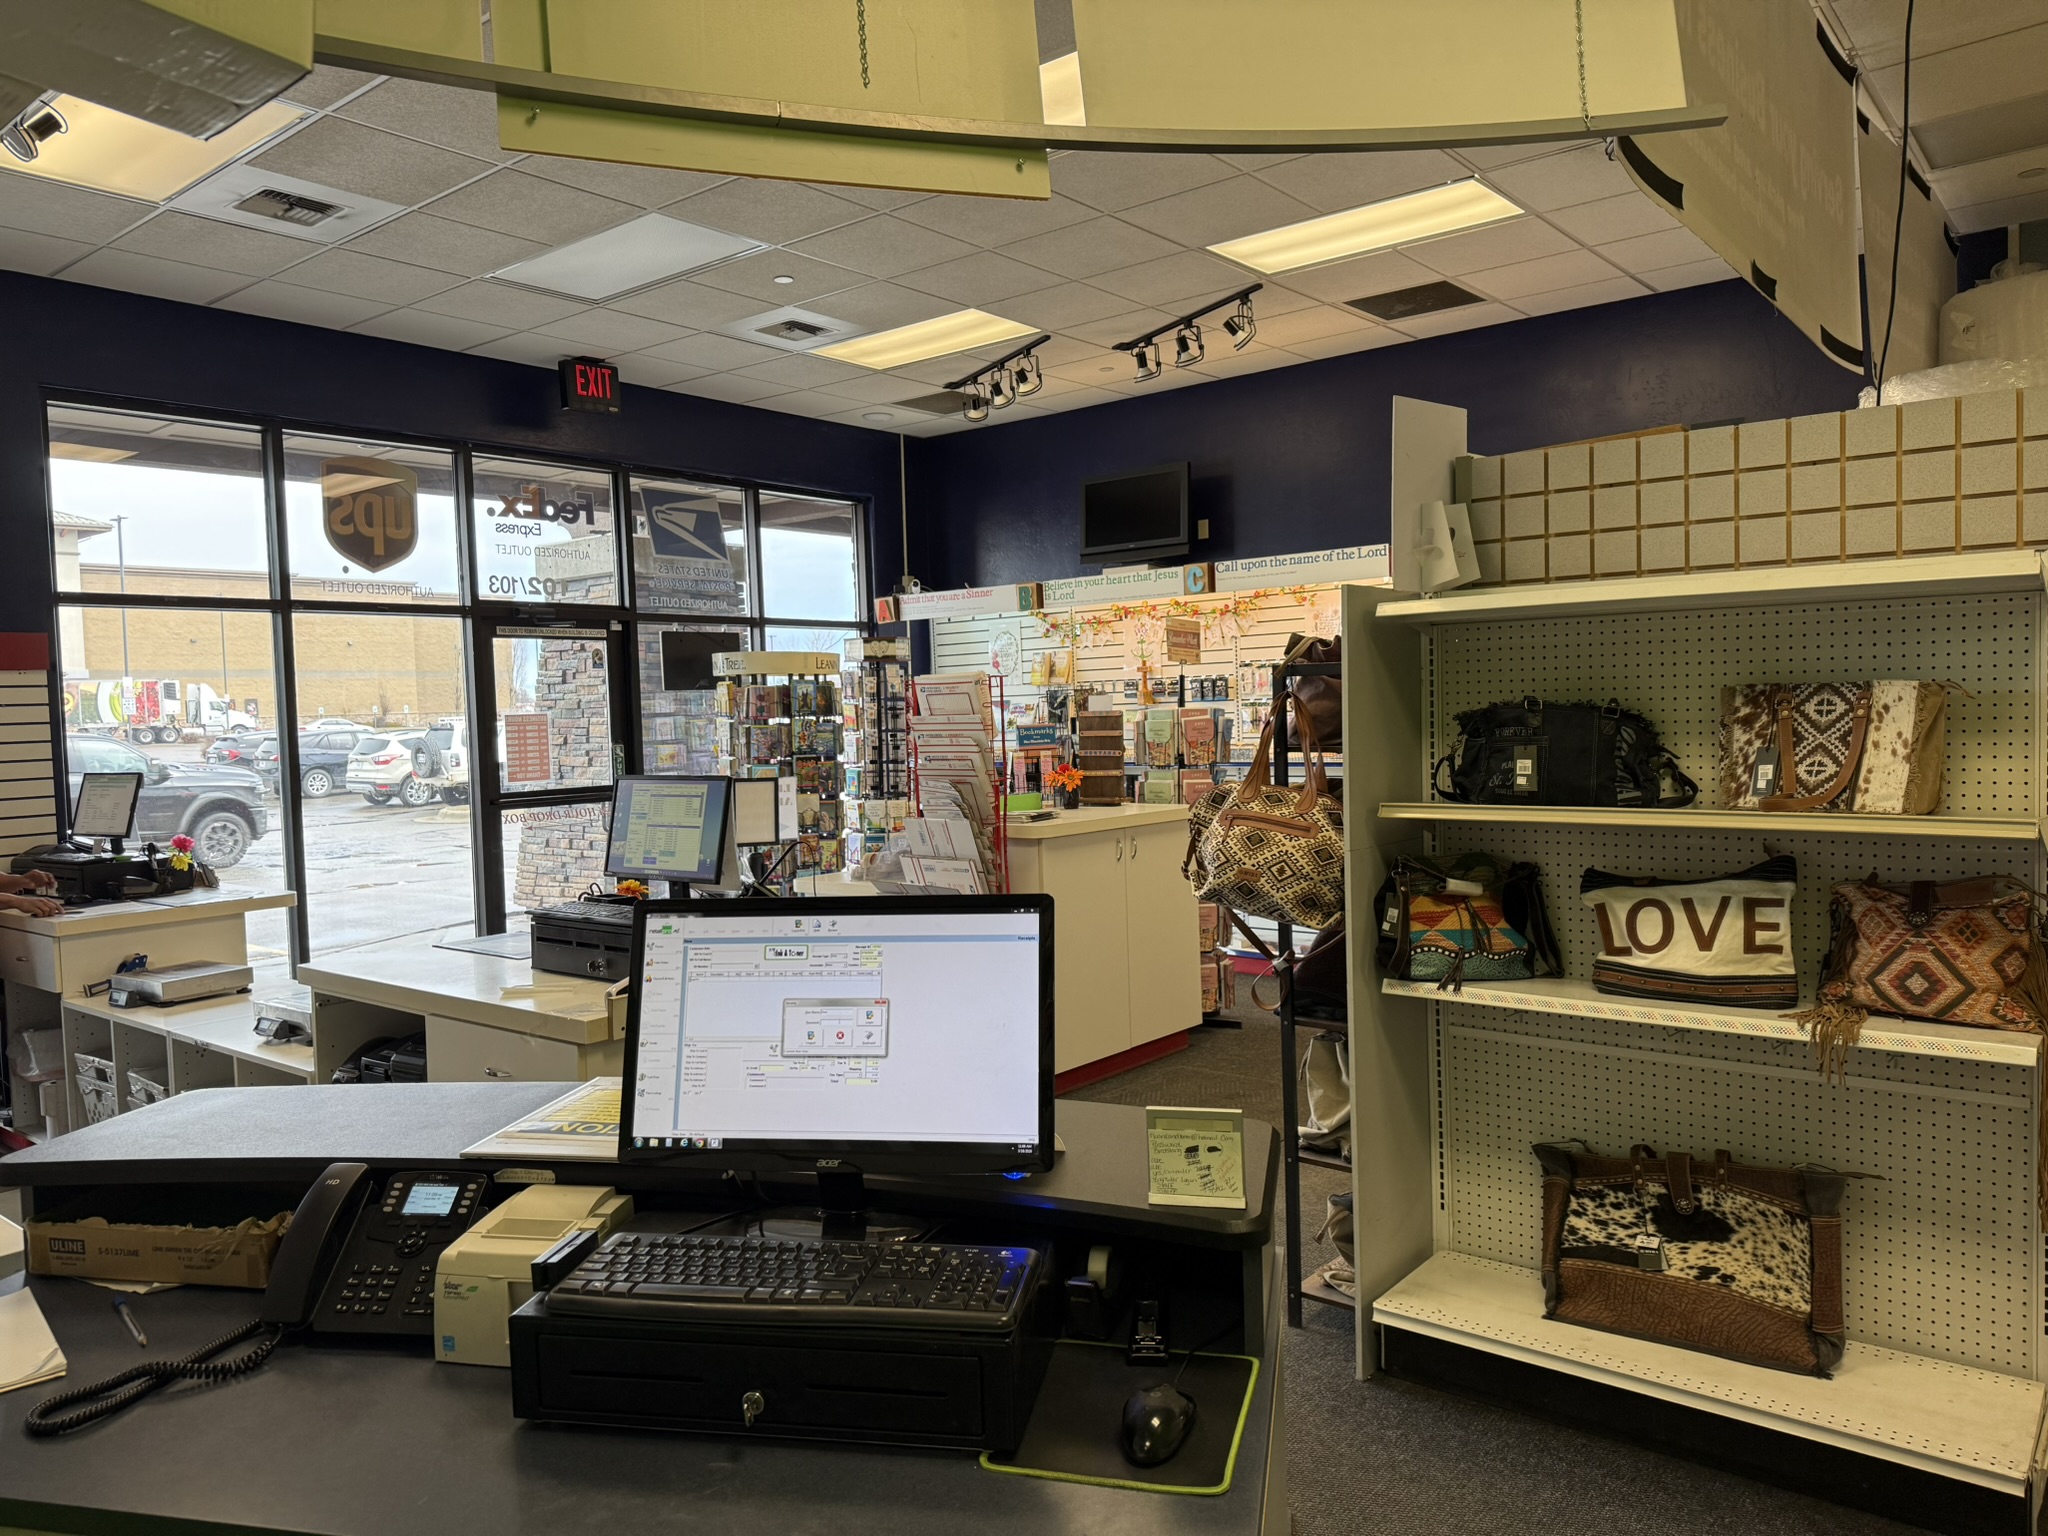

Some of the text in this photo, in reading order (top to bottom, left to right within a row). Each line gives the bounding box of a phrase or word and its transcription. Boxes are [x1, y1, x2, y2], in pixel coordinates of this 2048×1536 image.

[576, 364, 612, 399] EXIT
[1215, 545, 1387, 574] Call upon the name of the Lord
[1044, 569, 1179, 592] Believe in your heart that Jesus
[1187, 565, 1204, 593] C
[900, 595, 921, 606] Admit
[921, 594, 934, 603] that
[936, 594, 949, 604] you
[949, 593, 961, 601] are
[966, 589, 994, 599] Sinner
[1018, 586, 1033, 611] B
[1045, 591, 1052, 600] is
[1053, 589, 1075, 600] Lord
[878, 600, 892, 622] A
[1020, 728, 1053, 736] Bookmarks
[1494, 726, 1533, 737] FOREVER
[1594, 896, 1785, 957] LOVE
[816, 1158, 842, 1167] acer
[51, 1240, 84, 1253] ULINE
